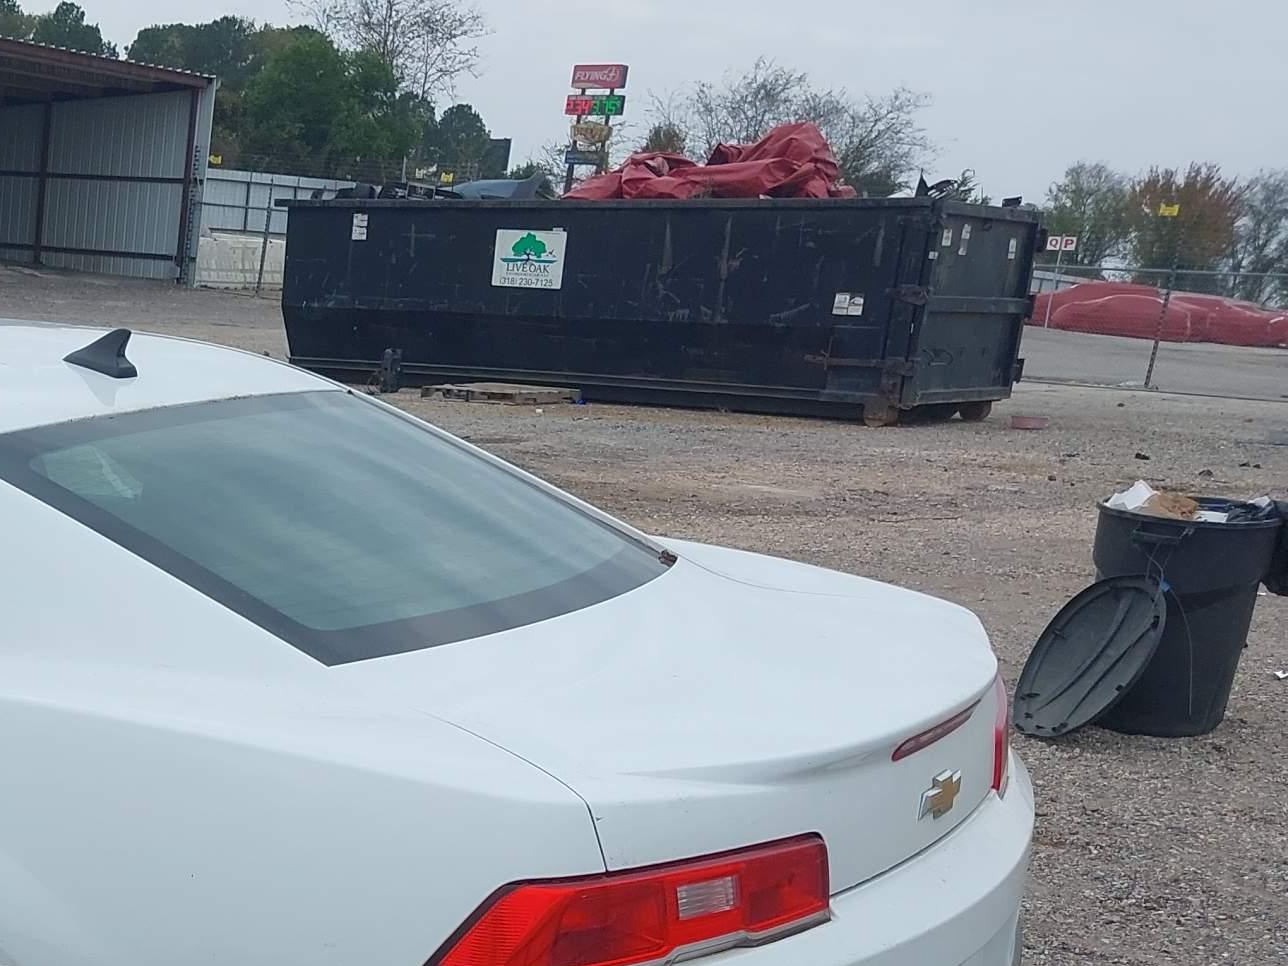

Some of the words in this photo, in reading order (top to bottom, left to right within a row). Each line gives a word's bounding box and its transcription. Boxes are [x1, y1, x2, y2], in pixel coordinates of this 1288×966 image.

[574, 71, 606, 81] FLYING
[1049, 238, 1058, 249] Q
[1064, 239, 1074, 248] P
[506, 262, 528, 273] LIVE
[528, 263, 550, 274] OAK
